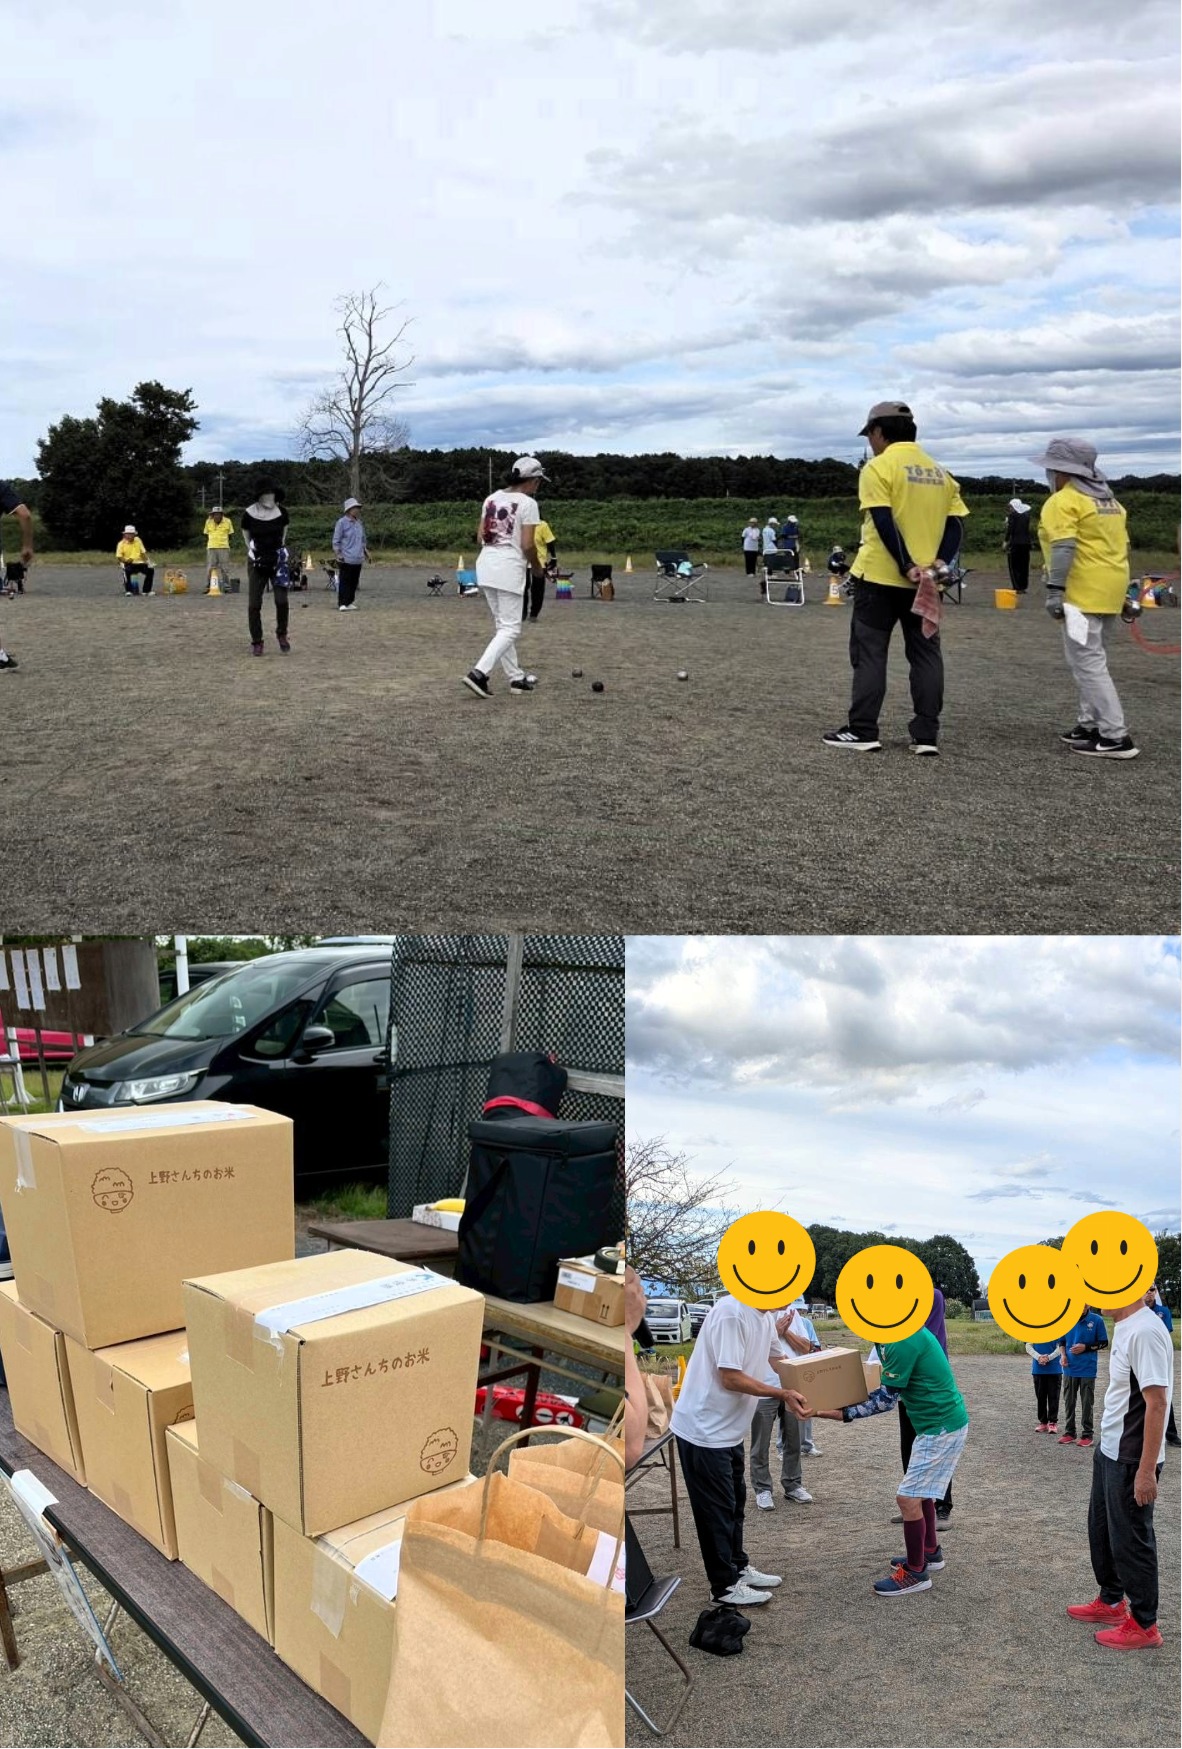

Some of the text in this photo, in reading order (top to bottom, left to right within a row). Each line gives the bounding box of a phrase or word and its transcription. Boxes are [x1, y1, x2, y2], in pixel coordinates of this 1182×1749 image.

[148, 1166, 235, 1184] 上野さんちのお米
[321, 1347, 430, 1387] 上野さんちのお米
